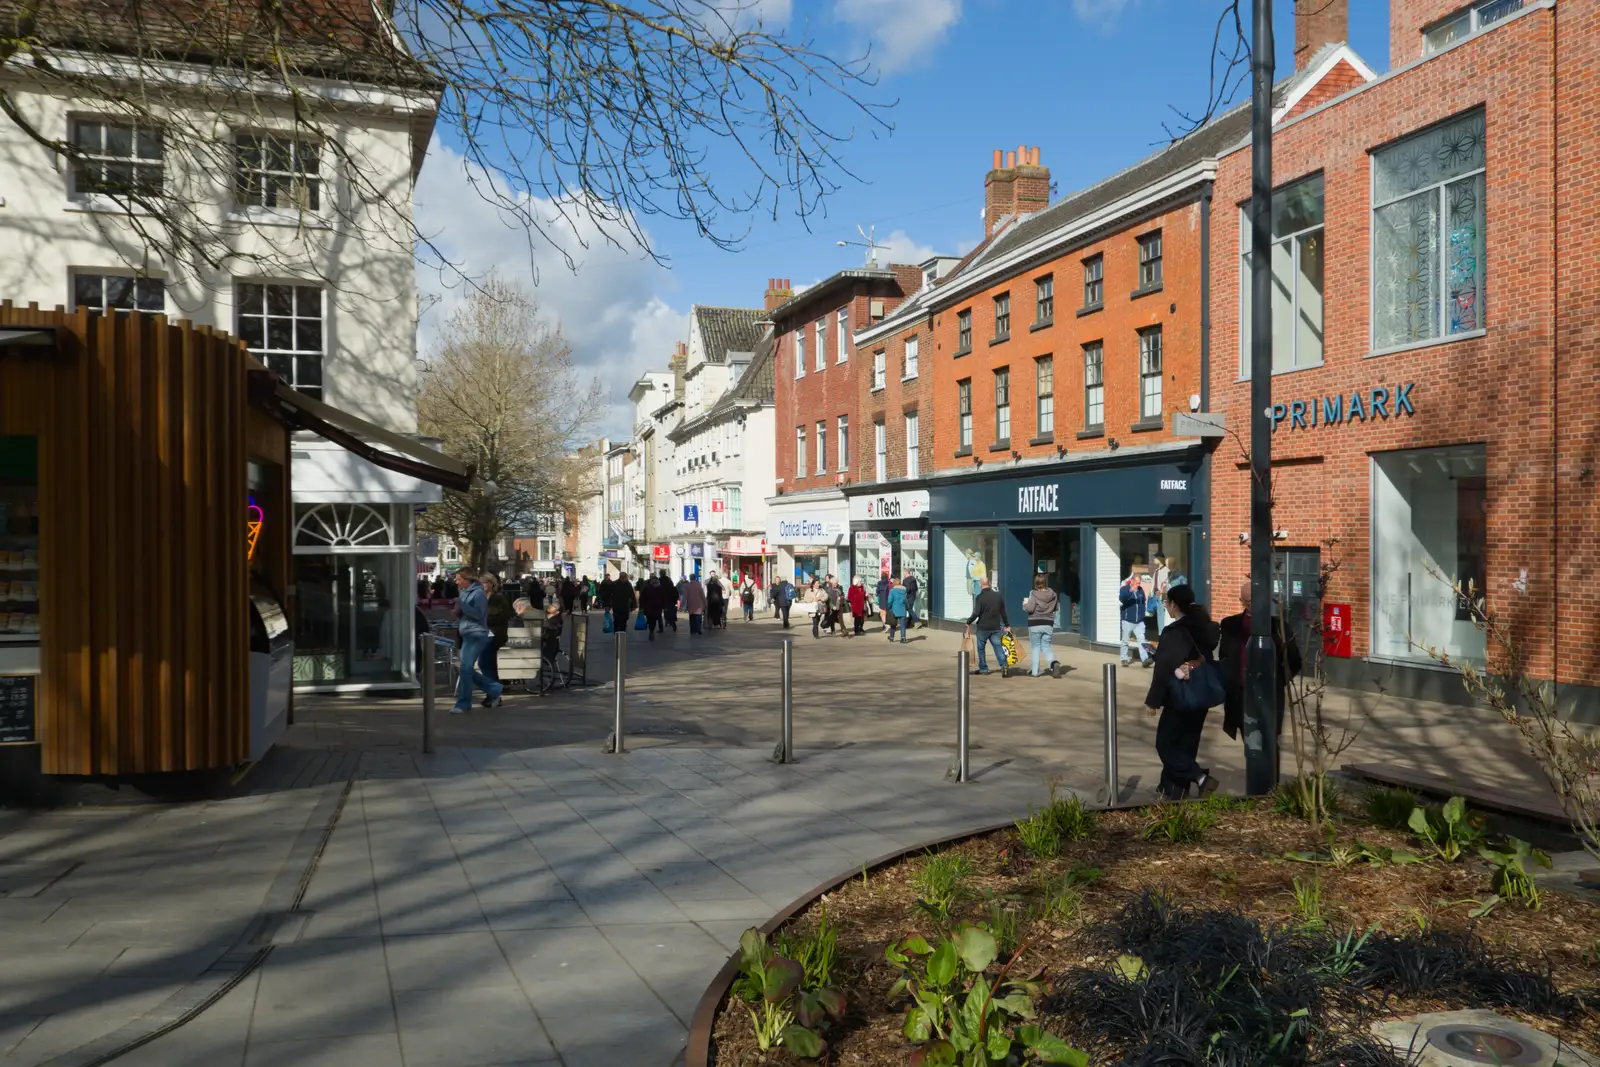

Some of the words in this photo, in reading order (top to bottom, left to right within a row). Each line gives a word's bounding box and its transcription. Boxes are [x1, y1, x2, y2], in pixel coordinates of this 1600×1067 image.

[1270, 383, 1416, 432] PRIMARK
[1160, 479, 1187, 491] FATFACE
[875, 496, 902, 518] iTech
[1018, 484, 1060, 513] FATFACE
[779, 520, 801, 540] Optical
[802, 520, 829, 540] Expre
